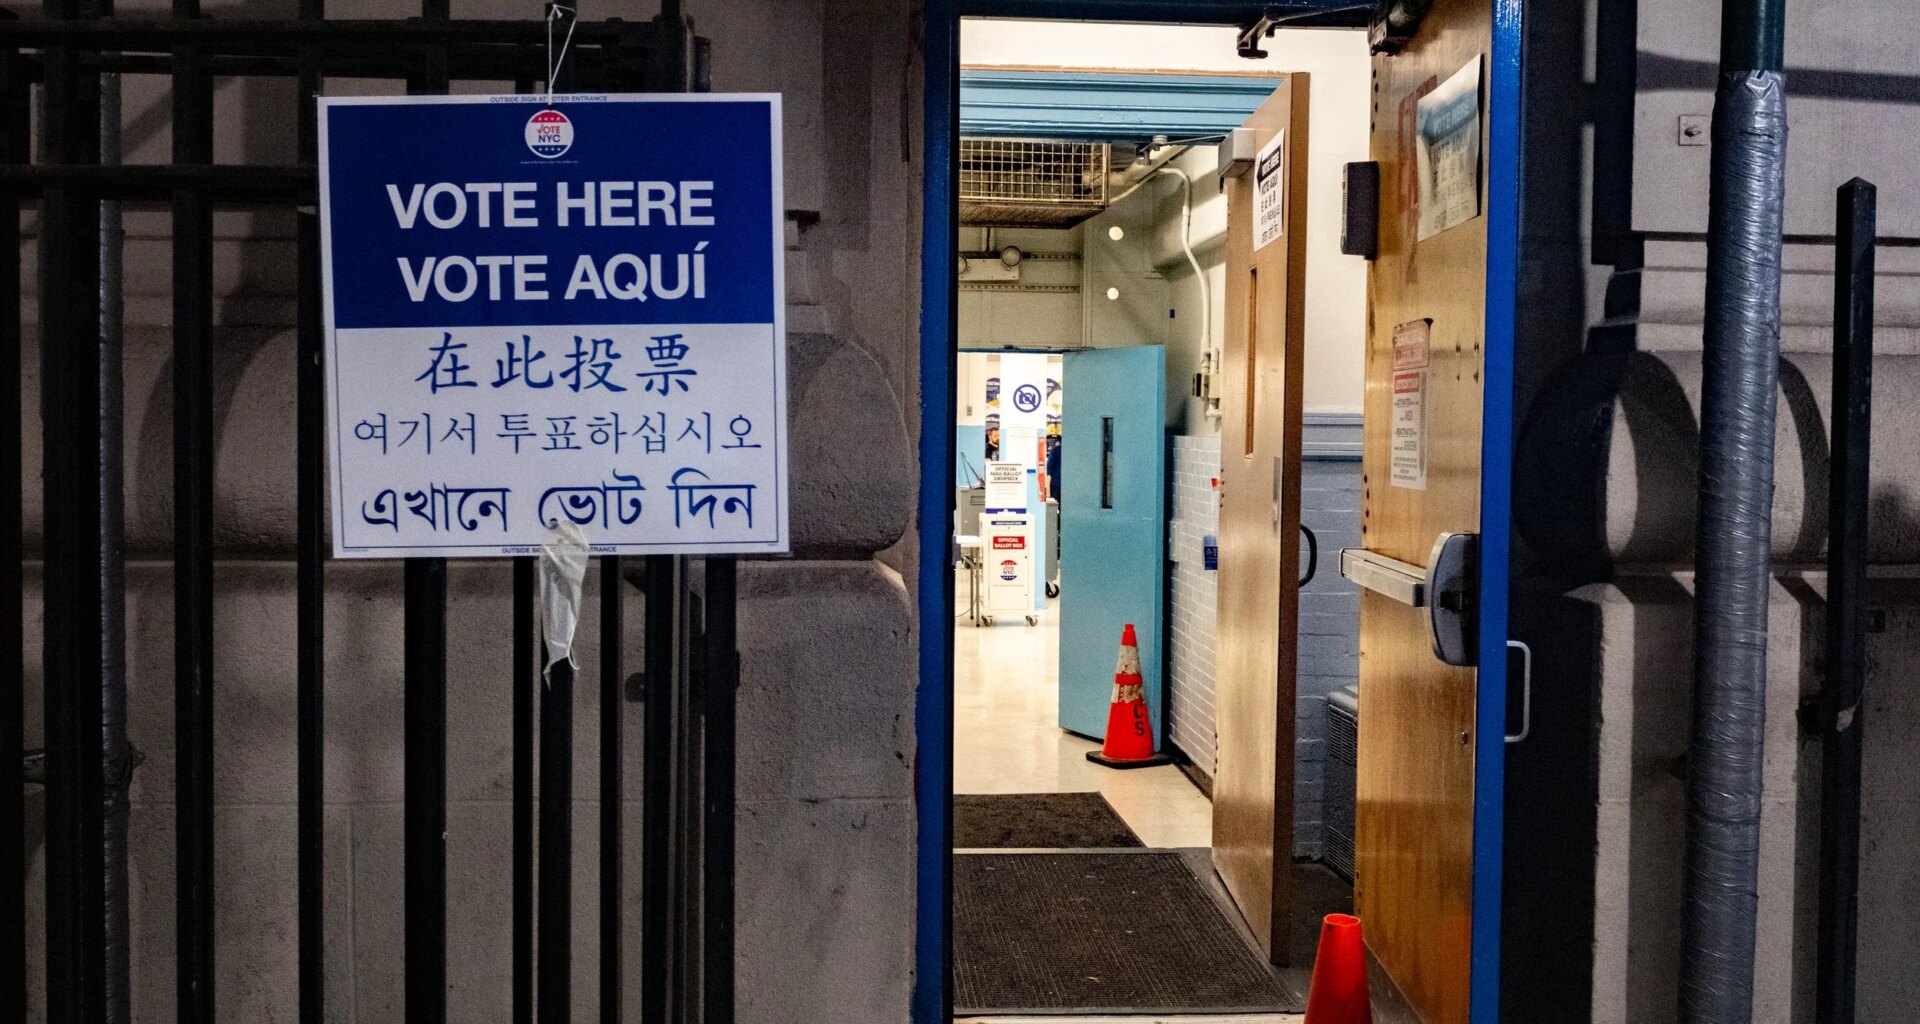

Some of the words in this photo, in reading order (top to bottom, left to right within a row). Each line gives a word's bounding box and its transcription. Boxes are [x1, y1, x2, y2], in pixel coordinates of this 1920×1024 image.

[538, 134, 561, 143] NYC
[387, 183, 538, 229] VOTE
[558, 181, 715, 227] HERE
[398, 255, 549, 302] VOTE
[564, 241, 709, 302] AQUÍ
[415, 331, 698, 396] 在此投票
[354, 412, 477, 455] 여기서
[496, 412, 762, 455] 투표하십시오
[361, 482, 511, 532] এখানে
[538, 469, 646, 530] ভোট
[666, 467, 757, 529] দিন
